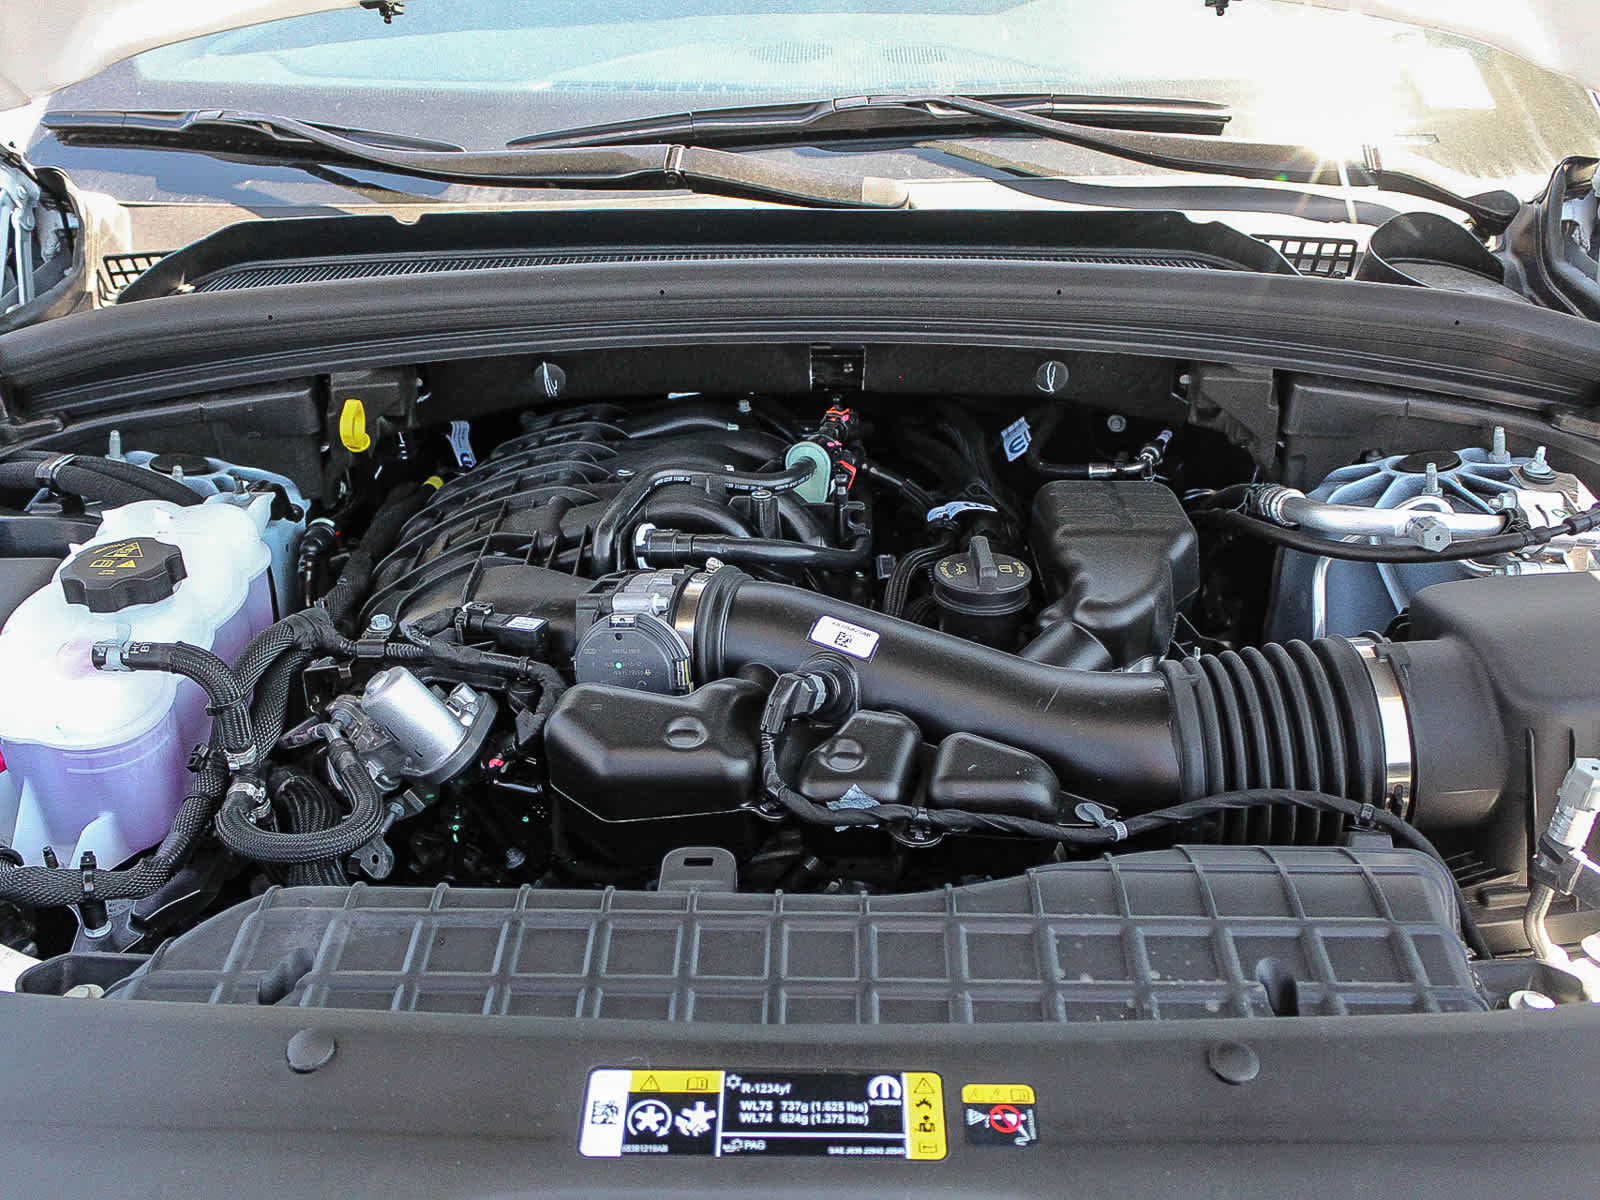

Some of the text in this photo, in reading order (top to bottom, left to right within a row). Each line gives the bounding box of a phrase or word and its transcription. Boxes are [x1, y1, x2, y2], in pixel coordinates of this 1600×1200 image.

[739, 1100, 774, 1112] WL75
[780, 1100, 809, 1113] 737g
[846, 1100, 869, 1114] lbs)
[739, 1112, 773, 1124] WL74
[846, 1113, 870, 1126] lbs)
